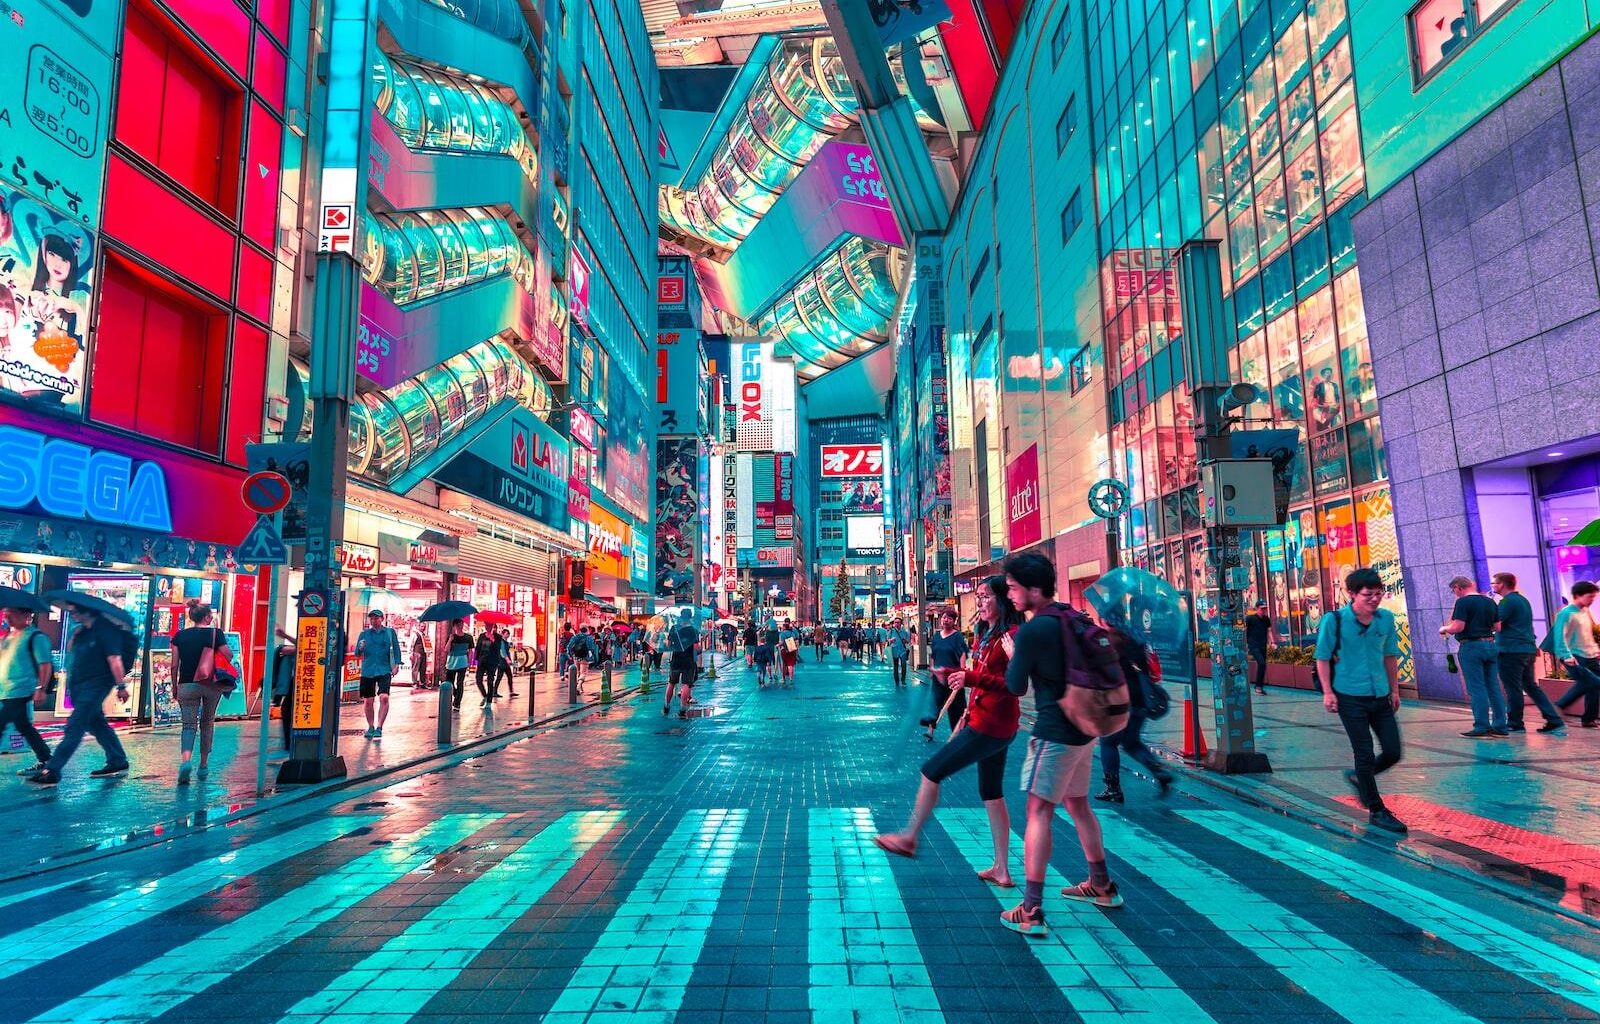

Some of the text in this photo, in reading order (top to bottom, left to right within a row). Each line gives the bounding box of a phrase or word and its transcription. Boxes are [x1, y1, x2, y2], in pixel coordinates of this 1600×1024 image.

[39, 67, 90, 115] 16:00
[0, 425, 172, 532] SEGA
[532, 432, 568, 482] LABI
[1011, 479, 1033, 522] atré
